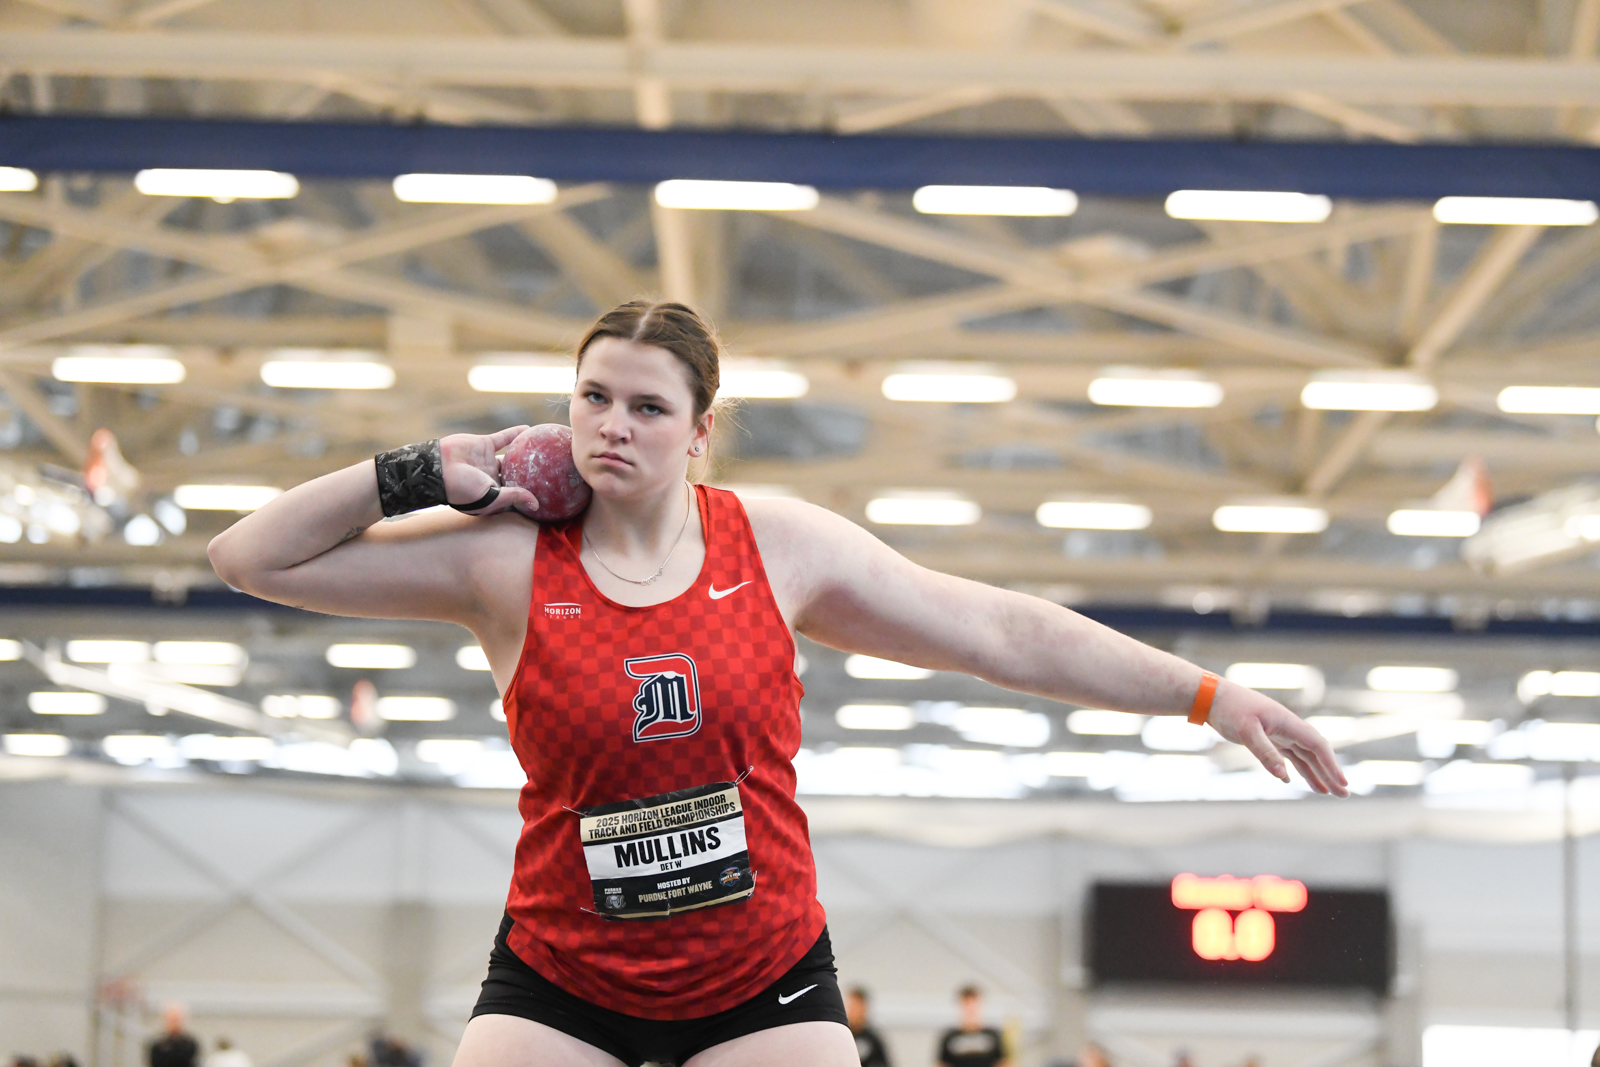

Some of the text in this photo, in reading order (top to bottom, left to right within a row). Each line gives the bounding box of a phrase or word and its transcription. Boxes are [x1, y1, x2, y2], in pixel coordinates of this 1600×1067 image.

[544, 606, 582, 615] HORIZON
[589, 802, 736, 839] TRACK AND FIELD CHAMPIONSHIPS
[596, 794, 726, 828] 2025 HORIZON LEAGUE INDOOR
[613, 826, 721, 868] MULLINS
[660, 860, 682, 871] DET W
[638, 881, 713, 903] PURDUE FORT WAYNE
[657, 876, 691, 890] HOSTED BY
